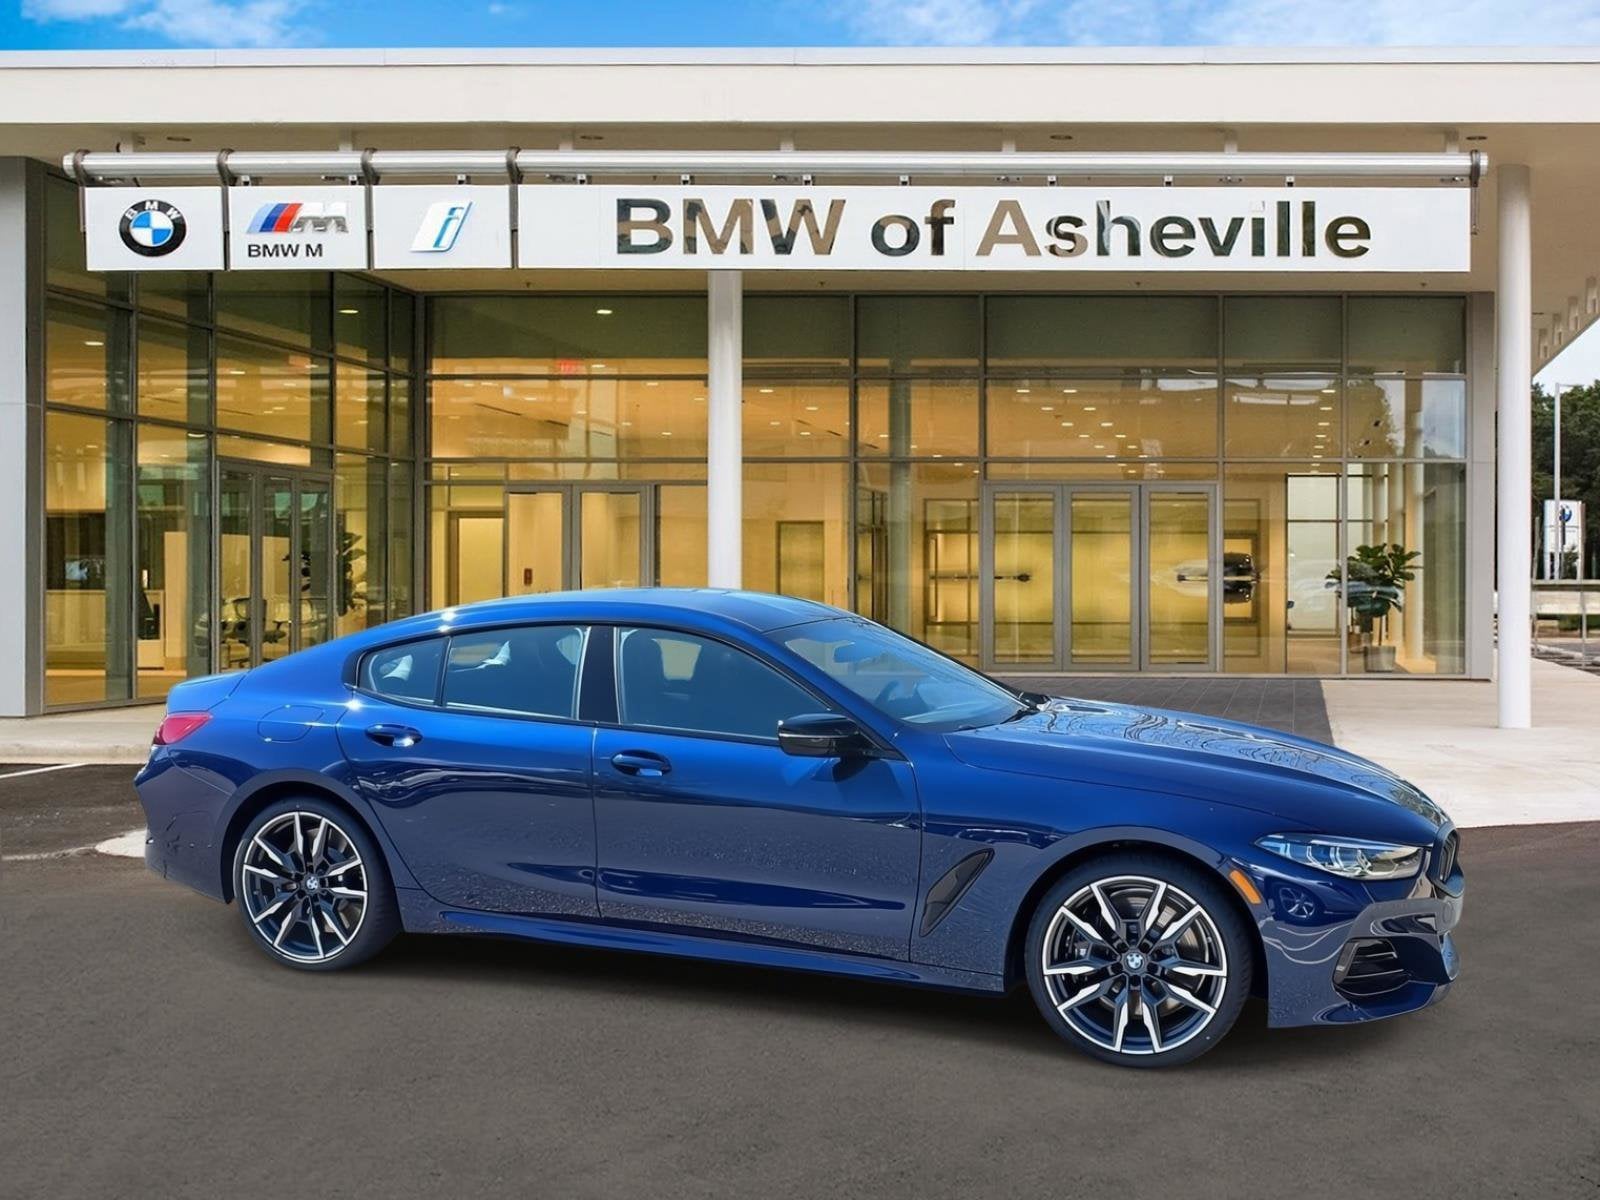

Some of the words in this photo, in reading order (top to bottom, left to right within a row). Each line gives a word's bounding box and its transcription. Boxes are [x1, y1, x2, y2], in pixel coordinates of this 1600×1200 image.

[125, 199, 182, 220] BMW
[616, 198, 846, 255] BMW
[871, 199, 956, 257] of
[975, 199, 1372, 258] Asheville
[248, 243, 300, 258] BMW
[305, 243, 323, 258] M
